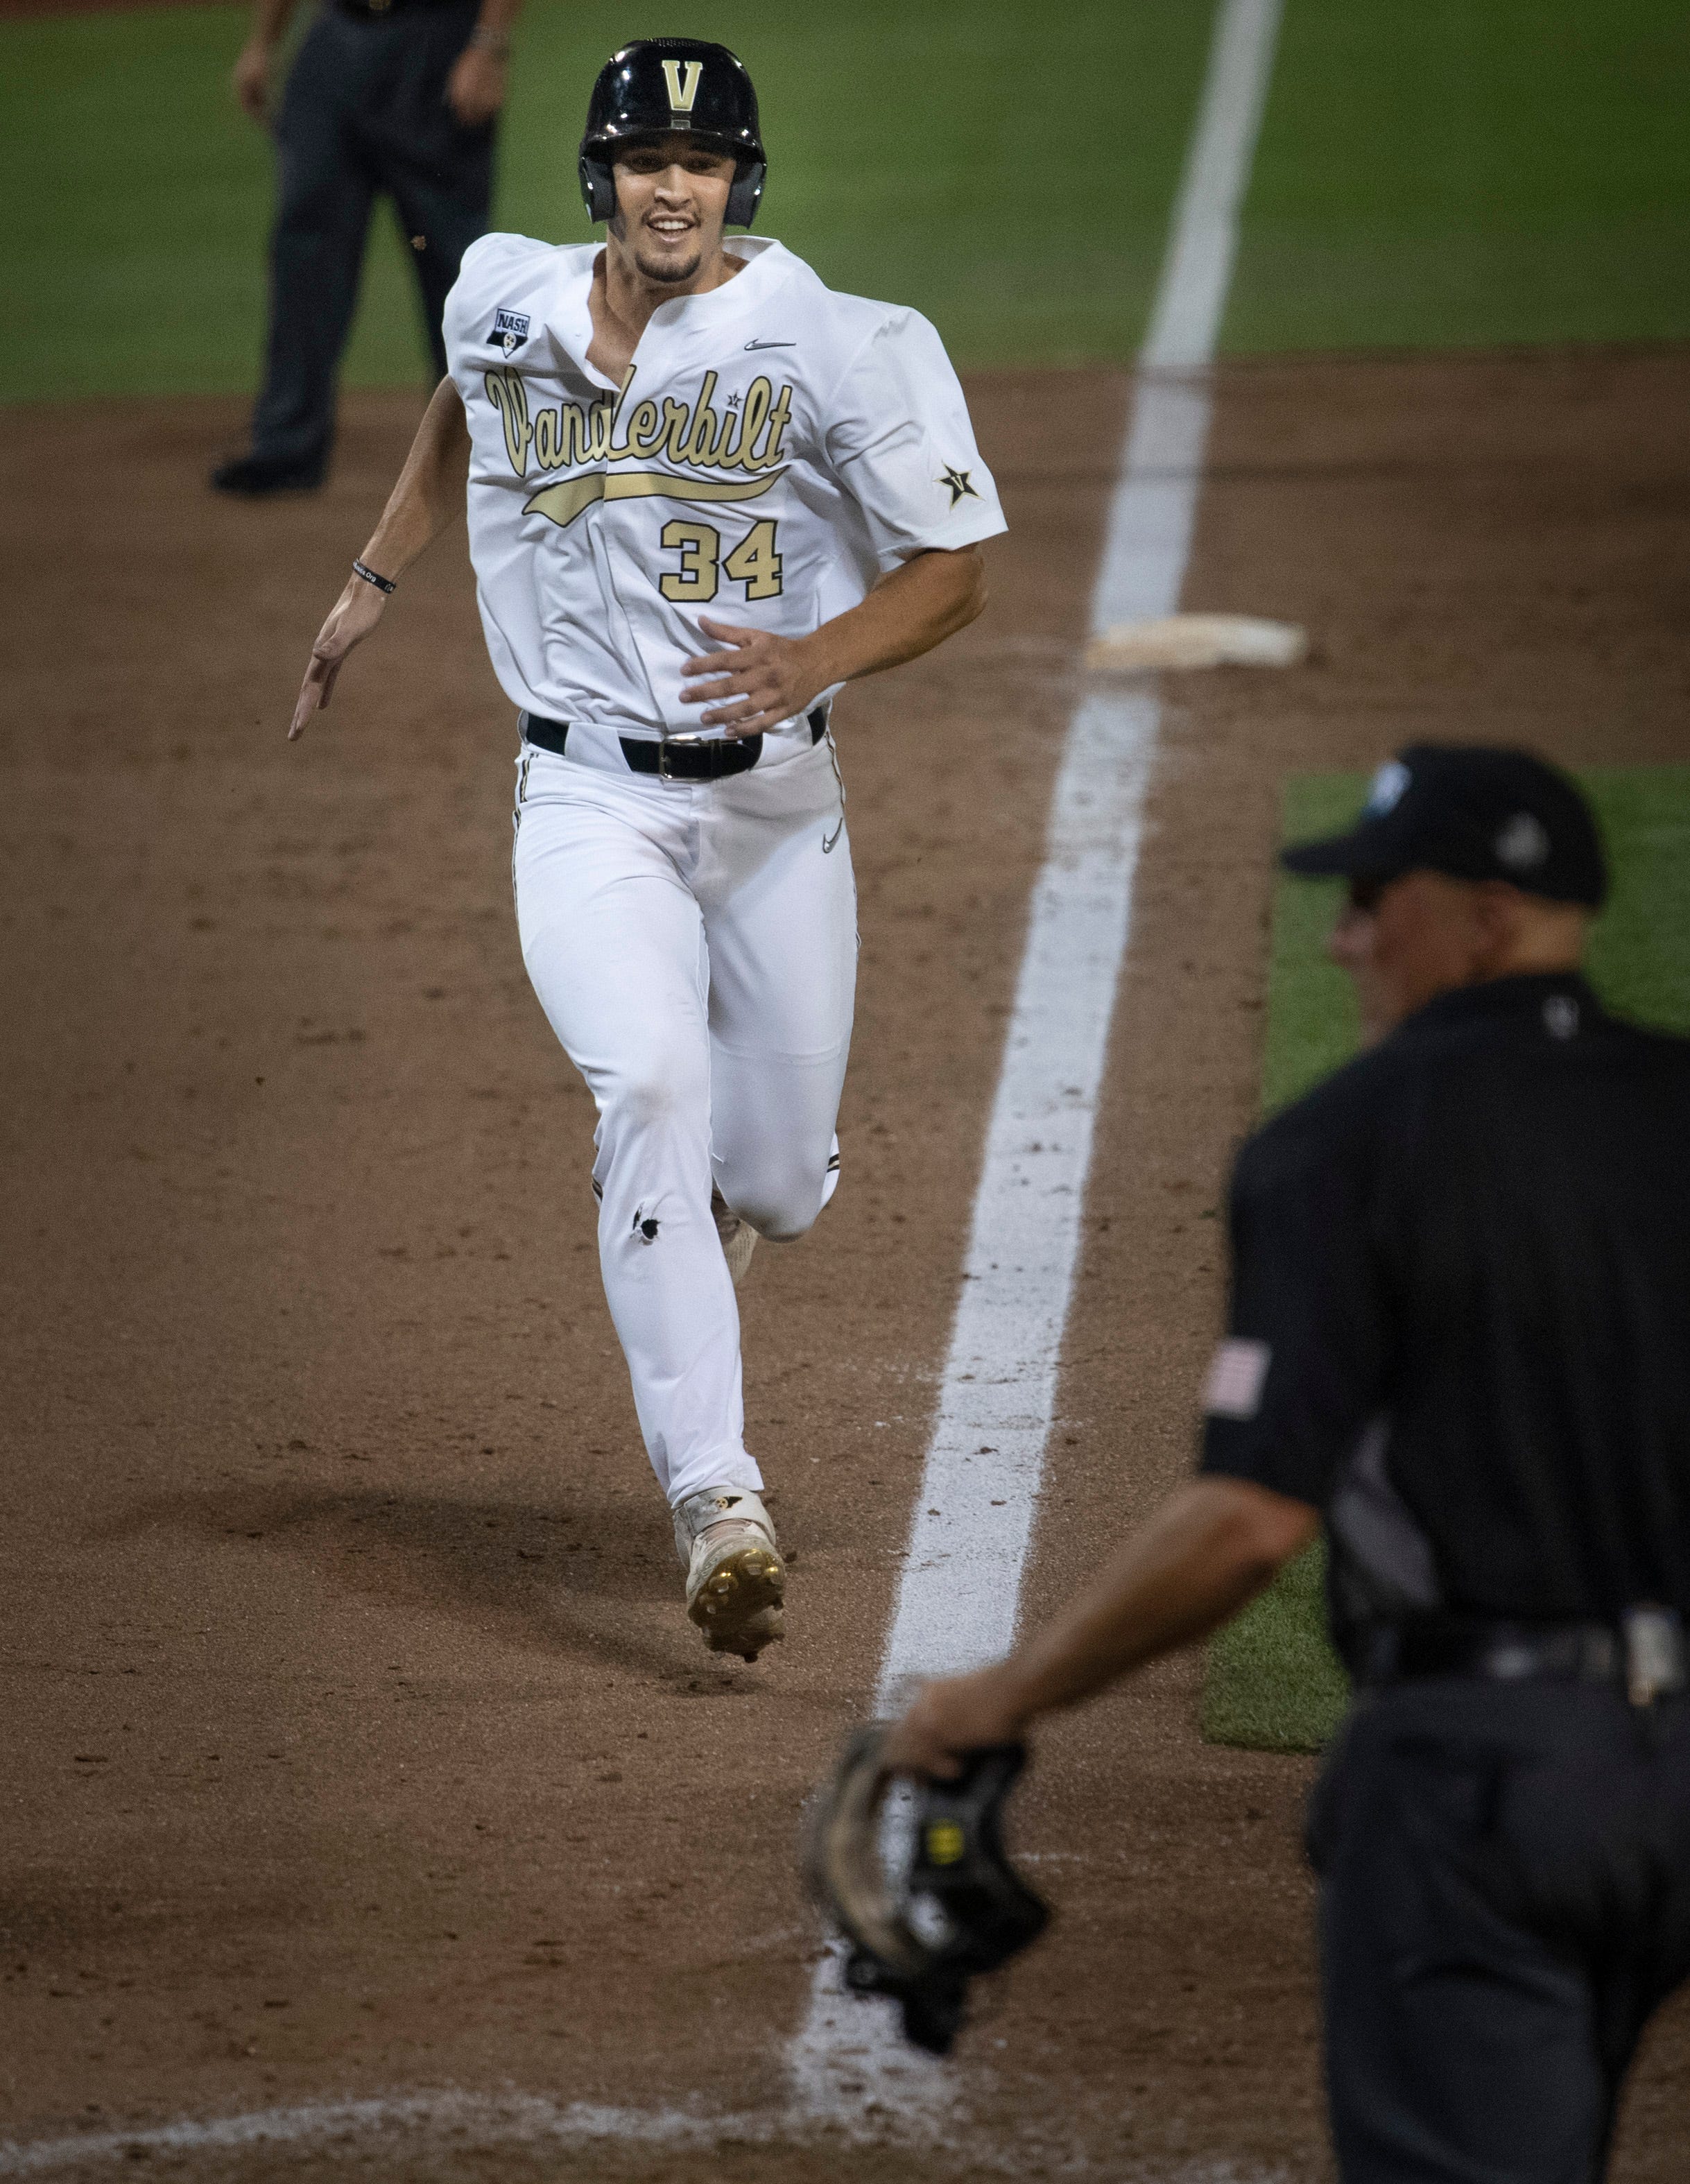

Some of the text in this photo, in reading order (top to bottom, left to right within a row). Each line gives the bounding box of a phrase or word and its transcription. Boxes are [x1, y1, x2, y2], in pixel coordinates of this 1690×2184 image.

[662, 60, 703, 112] V
[497, 313, 528, 334] NASH
[485, 363, 793, 478] Vanderbilt
[951, 475, 965, 491] V
[659, 519, 783, 603] 34
